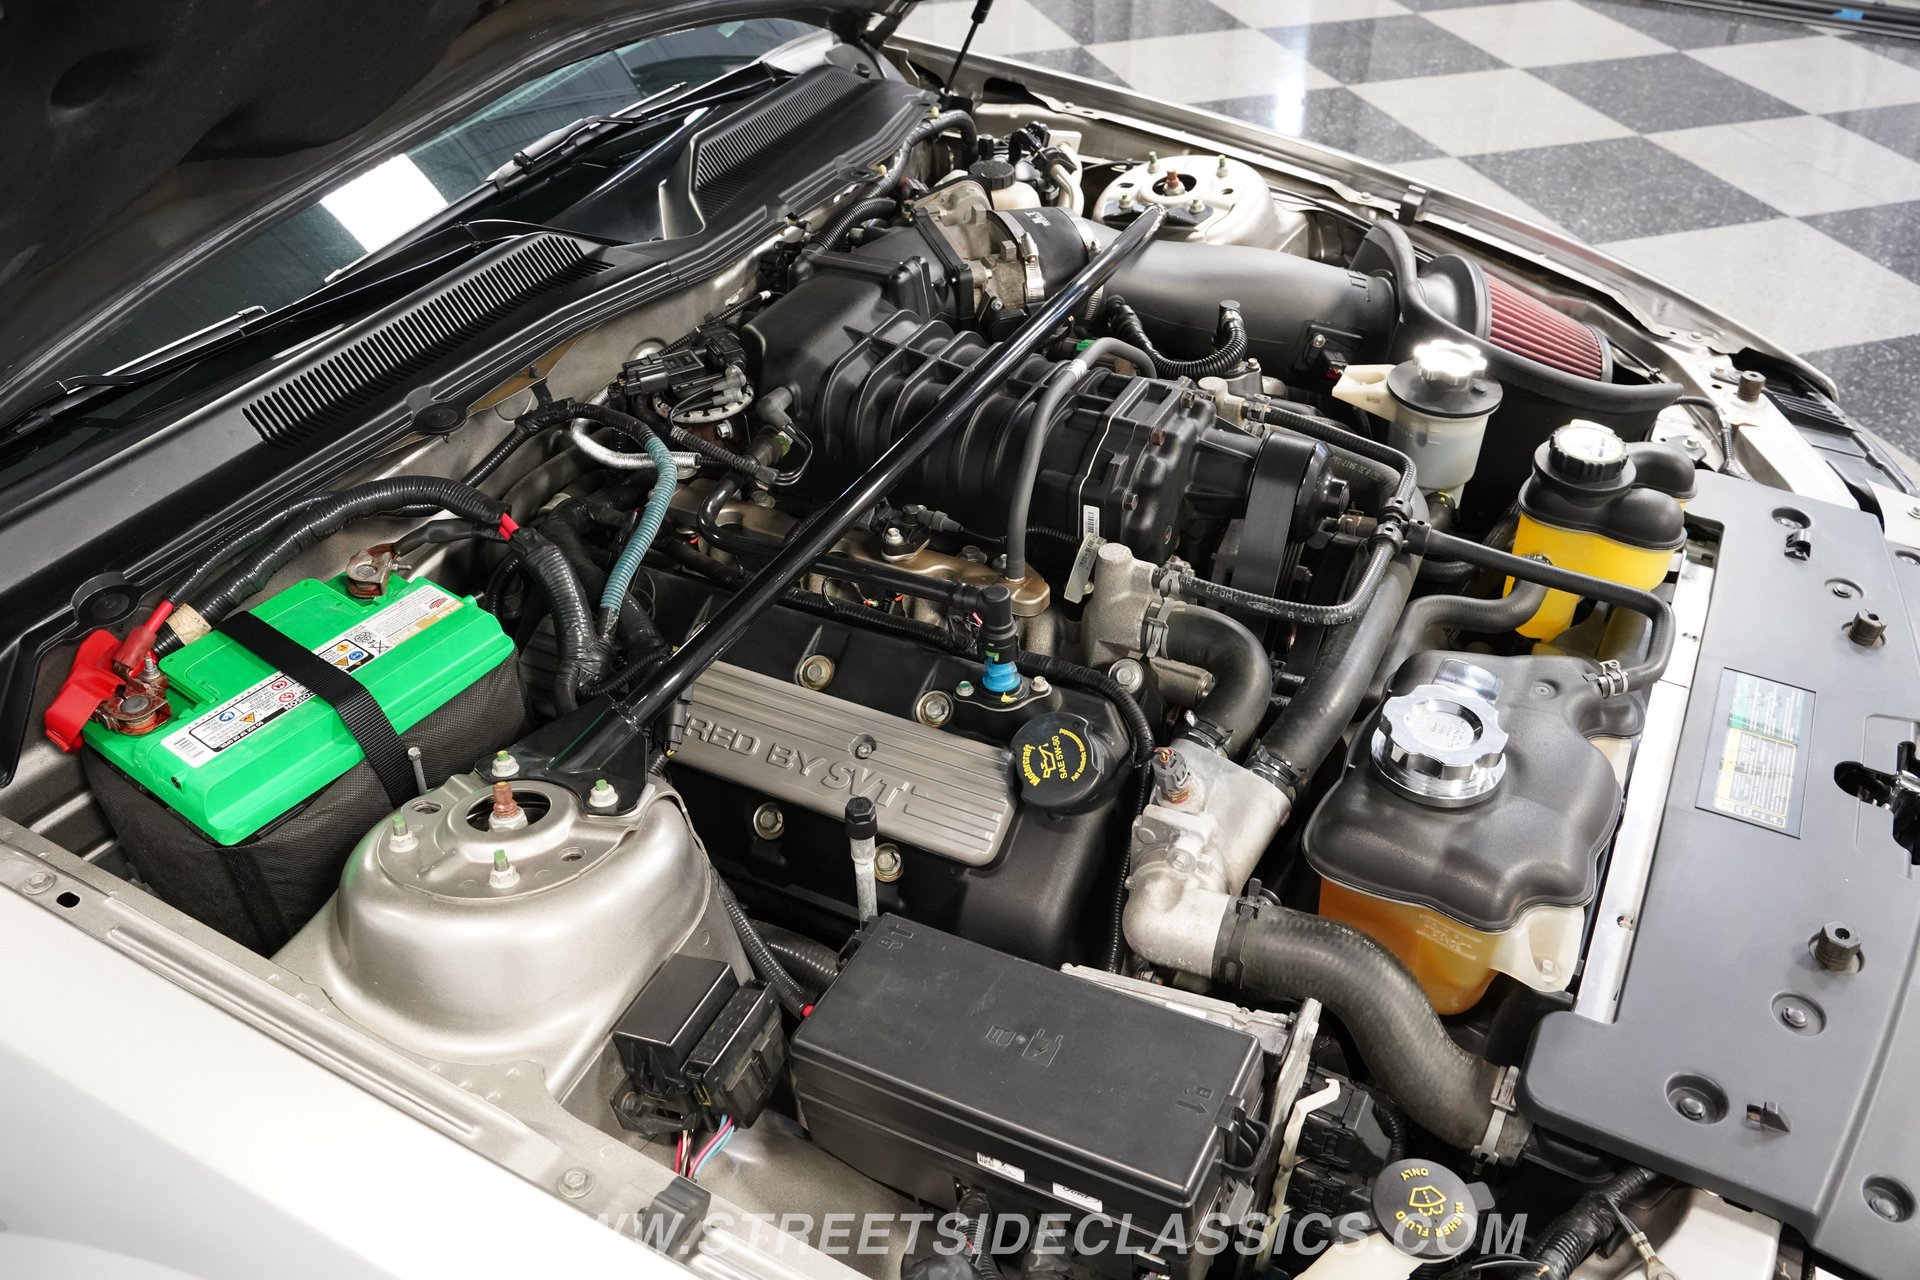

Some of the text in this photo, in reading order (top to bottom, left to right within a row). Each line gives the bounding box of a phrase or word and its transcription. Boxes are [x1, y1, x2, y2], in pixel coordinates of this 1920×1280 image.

[766, 742, 827, 777] BY
[820, 759, 911, 808] SVT
[1022, 743, 1041, 787] Motorcraft
[1052, 735, 1068, 779] SAE 5W-50
[1400, 1167, 1429, 1182] ONLY
[1395, 1201, 1465, 1238] WASHER FLUID
